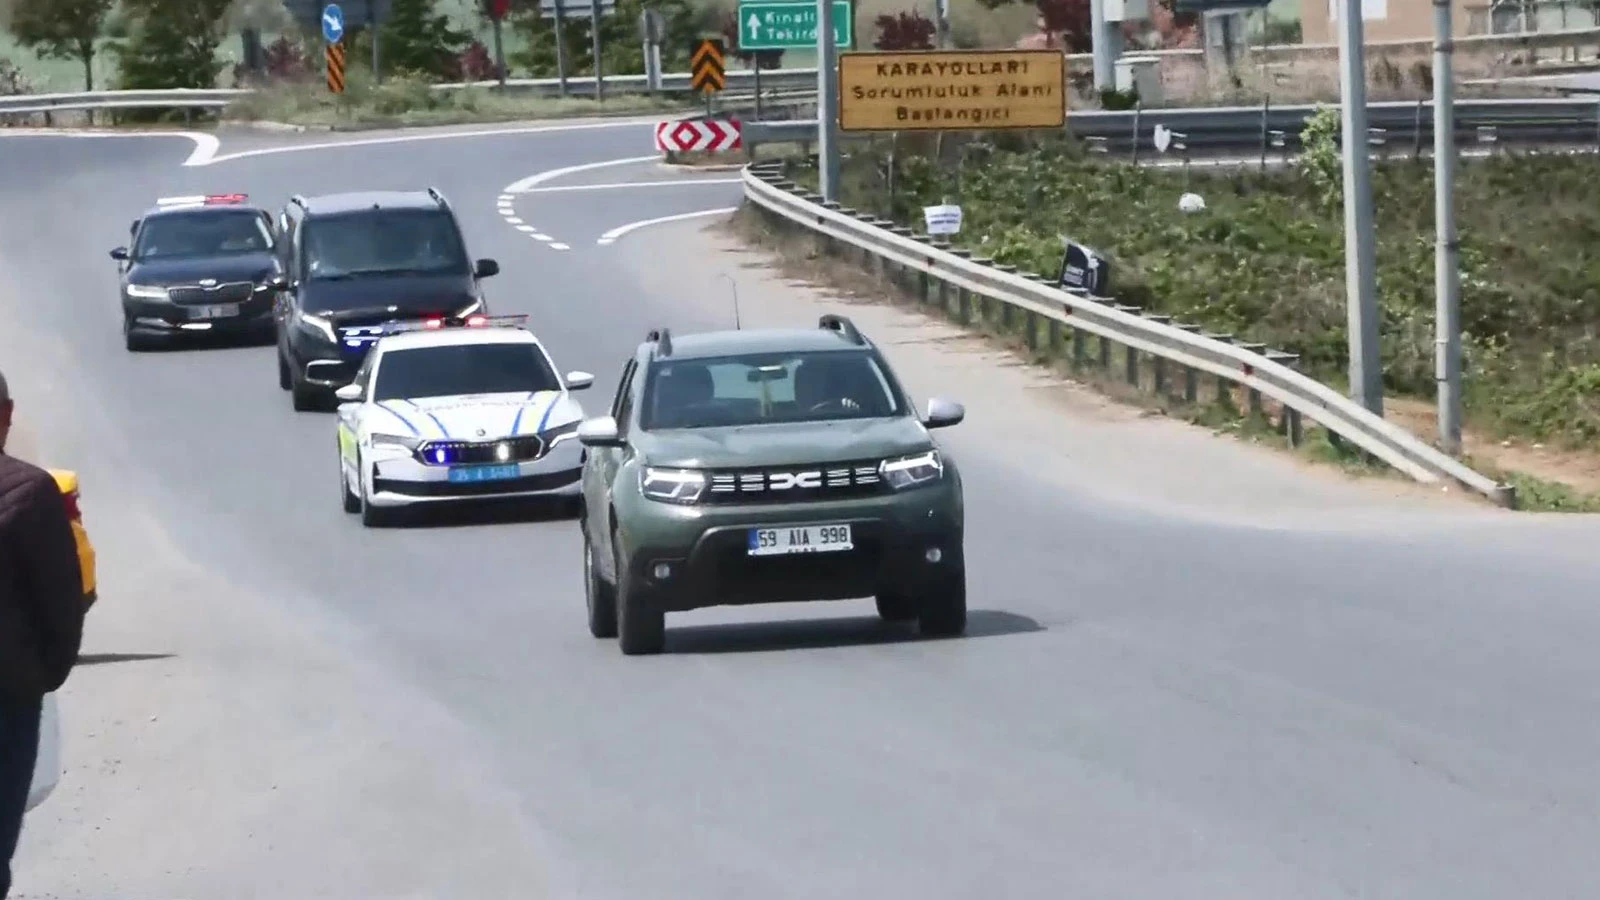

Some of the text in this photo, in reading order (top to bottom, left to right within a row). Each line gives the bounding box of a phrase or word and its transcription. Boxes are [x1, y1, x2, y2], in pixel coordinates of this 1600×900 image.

[876, 61, 1028, 77] KARAYOLLARI
[852, 84, 981, 100] Sorumluluk
[758, 530, 777, 548] 59
[820, 526, 848, 544] 998
